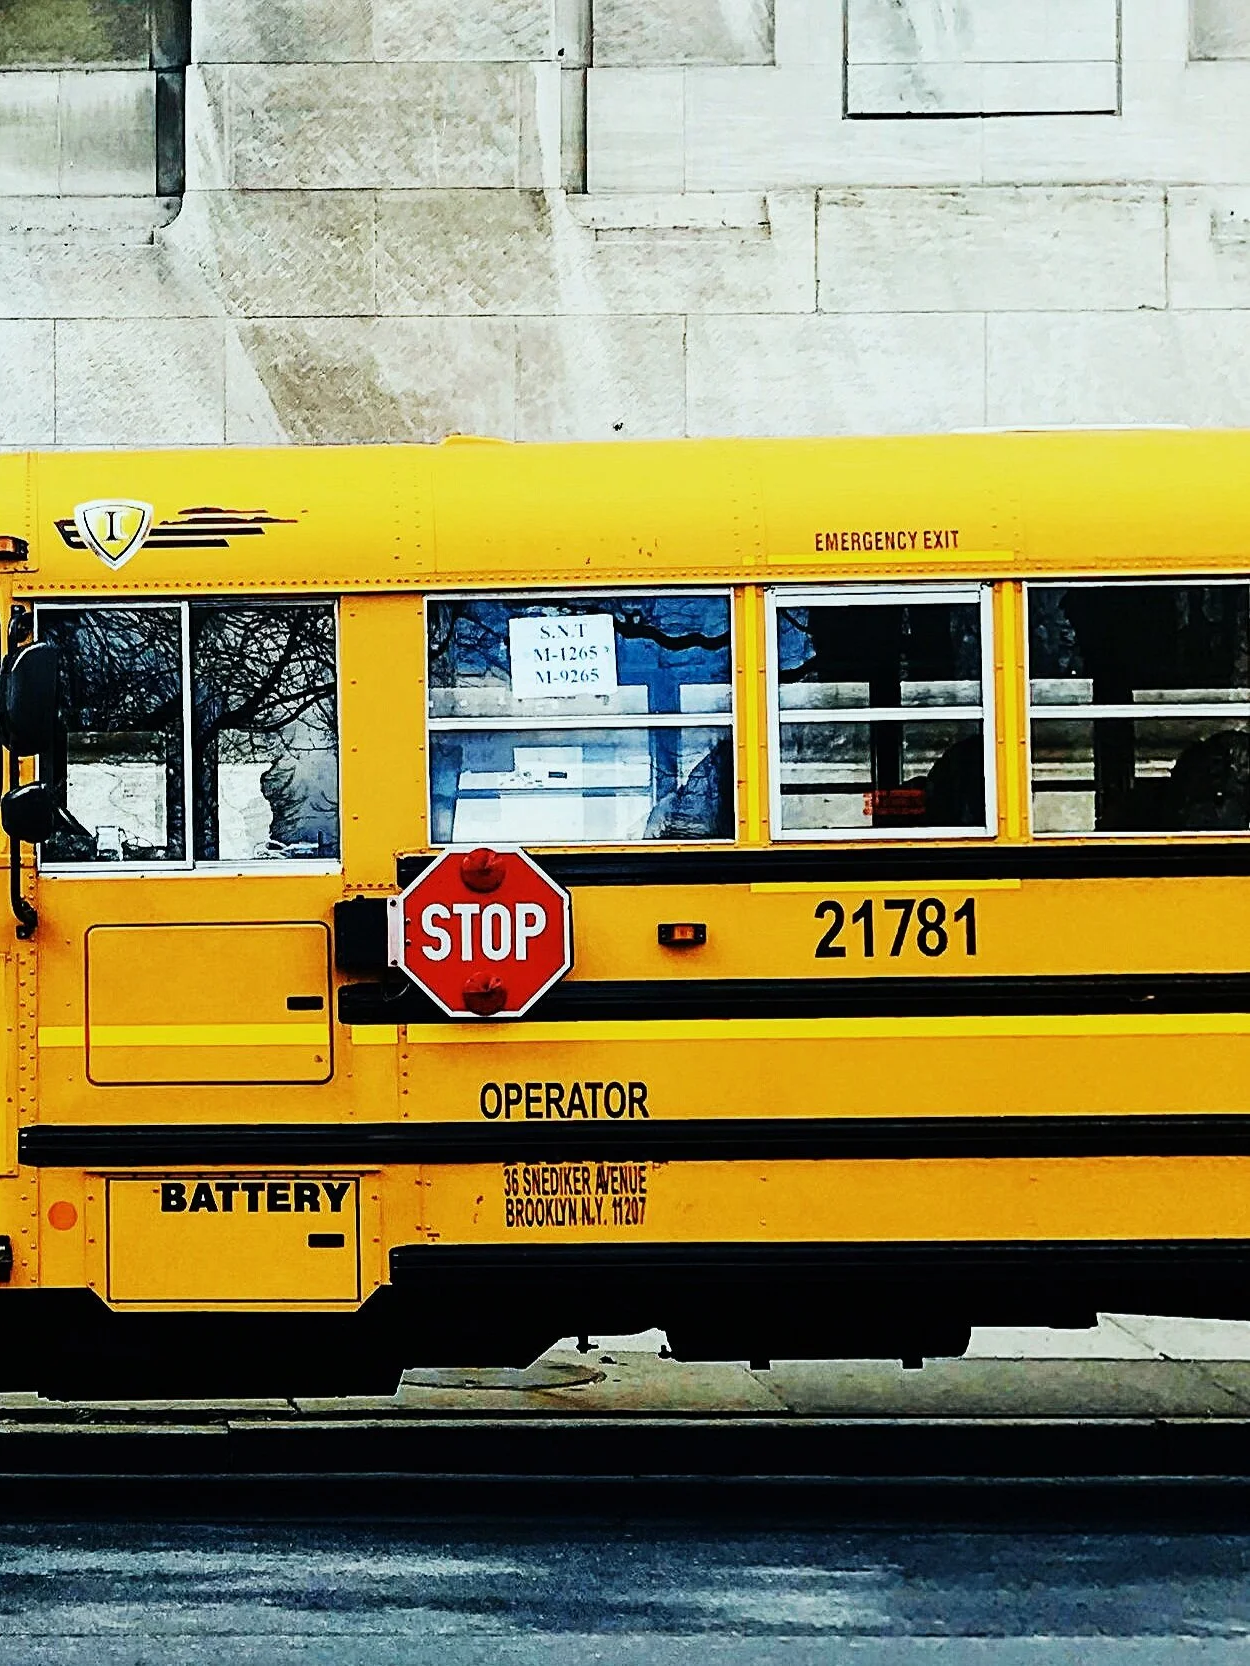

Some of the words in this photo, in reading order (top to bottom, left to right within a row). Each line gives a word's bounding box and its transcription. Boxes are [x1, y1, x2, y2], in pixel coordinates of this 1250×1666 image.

[814, 531, 917, 552] EMERGENCY
[923, 530, 959, 550] EXIT
[533, 645, 598, 662] M-1265
[535, 668, 600, 685] M-9265
[420, 902, 547, 962] STOP
[813, 897, 978, 959] 21781
[479, 1081, 649, 1120] OPERATOR
[503, 1167, 519, 1197] 36
[522, 1166, 592, 1196] SNEDIKER
[595, 1165, 648, 1196] AVENUE
[160, 1181, 351, 1214] BATTERY
[505, 1197, 578, 1228] BROOKLYN
[582, 1197, 608, 1227] N.Y.
[612, 1196, 648, 1226] 11207
